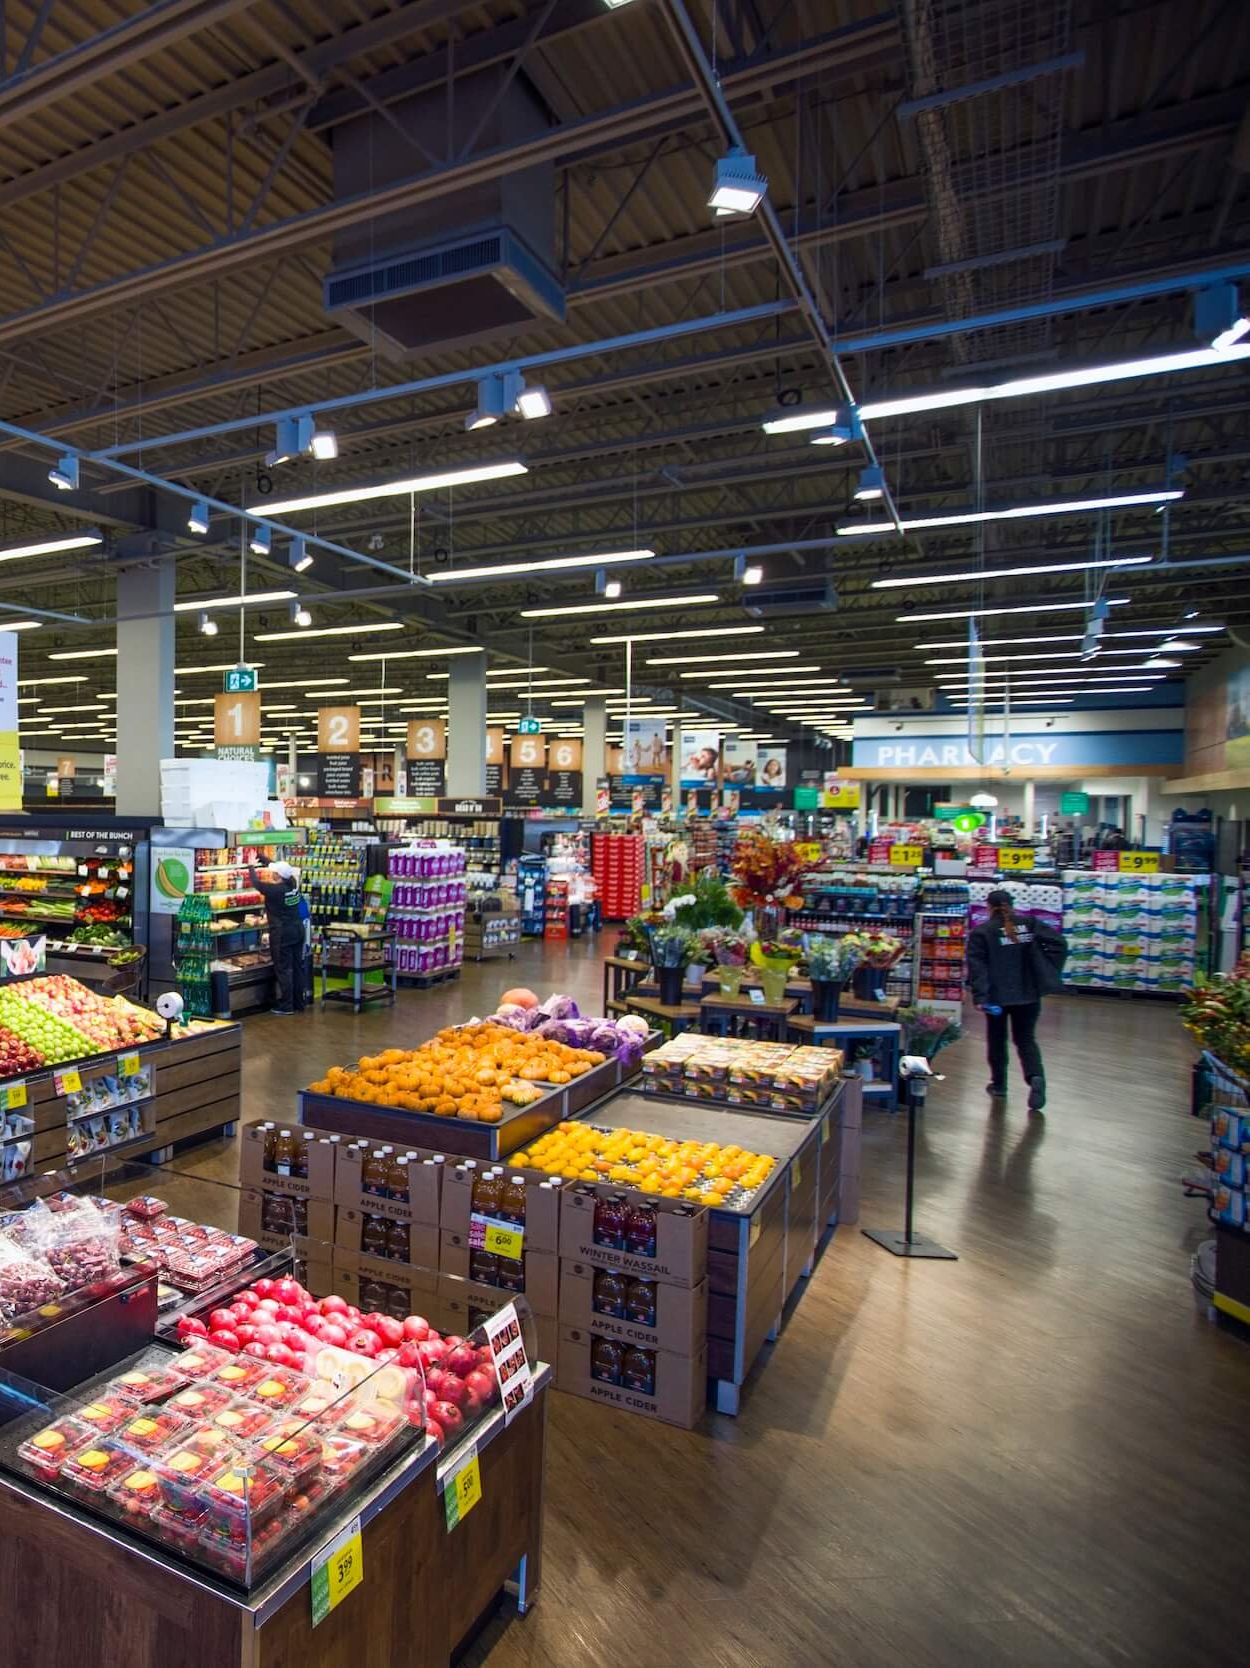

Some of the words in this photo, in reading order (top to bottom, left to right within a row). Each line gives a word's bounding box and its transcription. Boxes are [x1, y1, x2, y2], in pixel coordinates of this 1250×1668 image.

[228, 703, 243, 737] 1
[328, 715, 349, 746] 2
[415, 727, 435, 753] 3
[218, 747, 255, 755] NATURAL
[520, 741, 537, 763] 5
[556, 746, 573, 766] 6
[877, 743, 1058, 766] PHARACY
[62, 760, 71, 775] 7
[70, 831, 88, 839] BEST
[88, 831, 97, 839] OF
[98, 832, 110, 840] THE
[110, 832, 134, 841] BUNCH
[261, 1177, 286, 1188] APPLE
[287, 1182, 311, 1193] CIDER
[360, 1199, 385, 1210] APPLE
[388, 1206, 413, 1218] CIDER
[261, 1235, 285, 1246] APPLE
[469, 1239, 486, 1248] sale
[579, 1245, 621, 1264] WINTER
[622, 1256, 671, 1275] WASSAIL
[358, 1266, 383, 1278] APPLE
[385, 1272, 411, 1284] CIDER
[467, 1293, 496, 1306] APPLE
[591, 1319, 623, 1334] APPLE
[626, 1329, 659, 1344] CIDER
[590, 1386, 622, 1402] APPLE
[625, 1396, 658, 1412] CIDER
